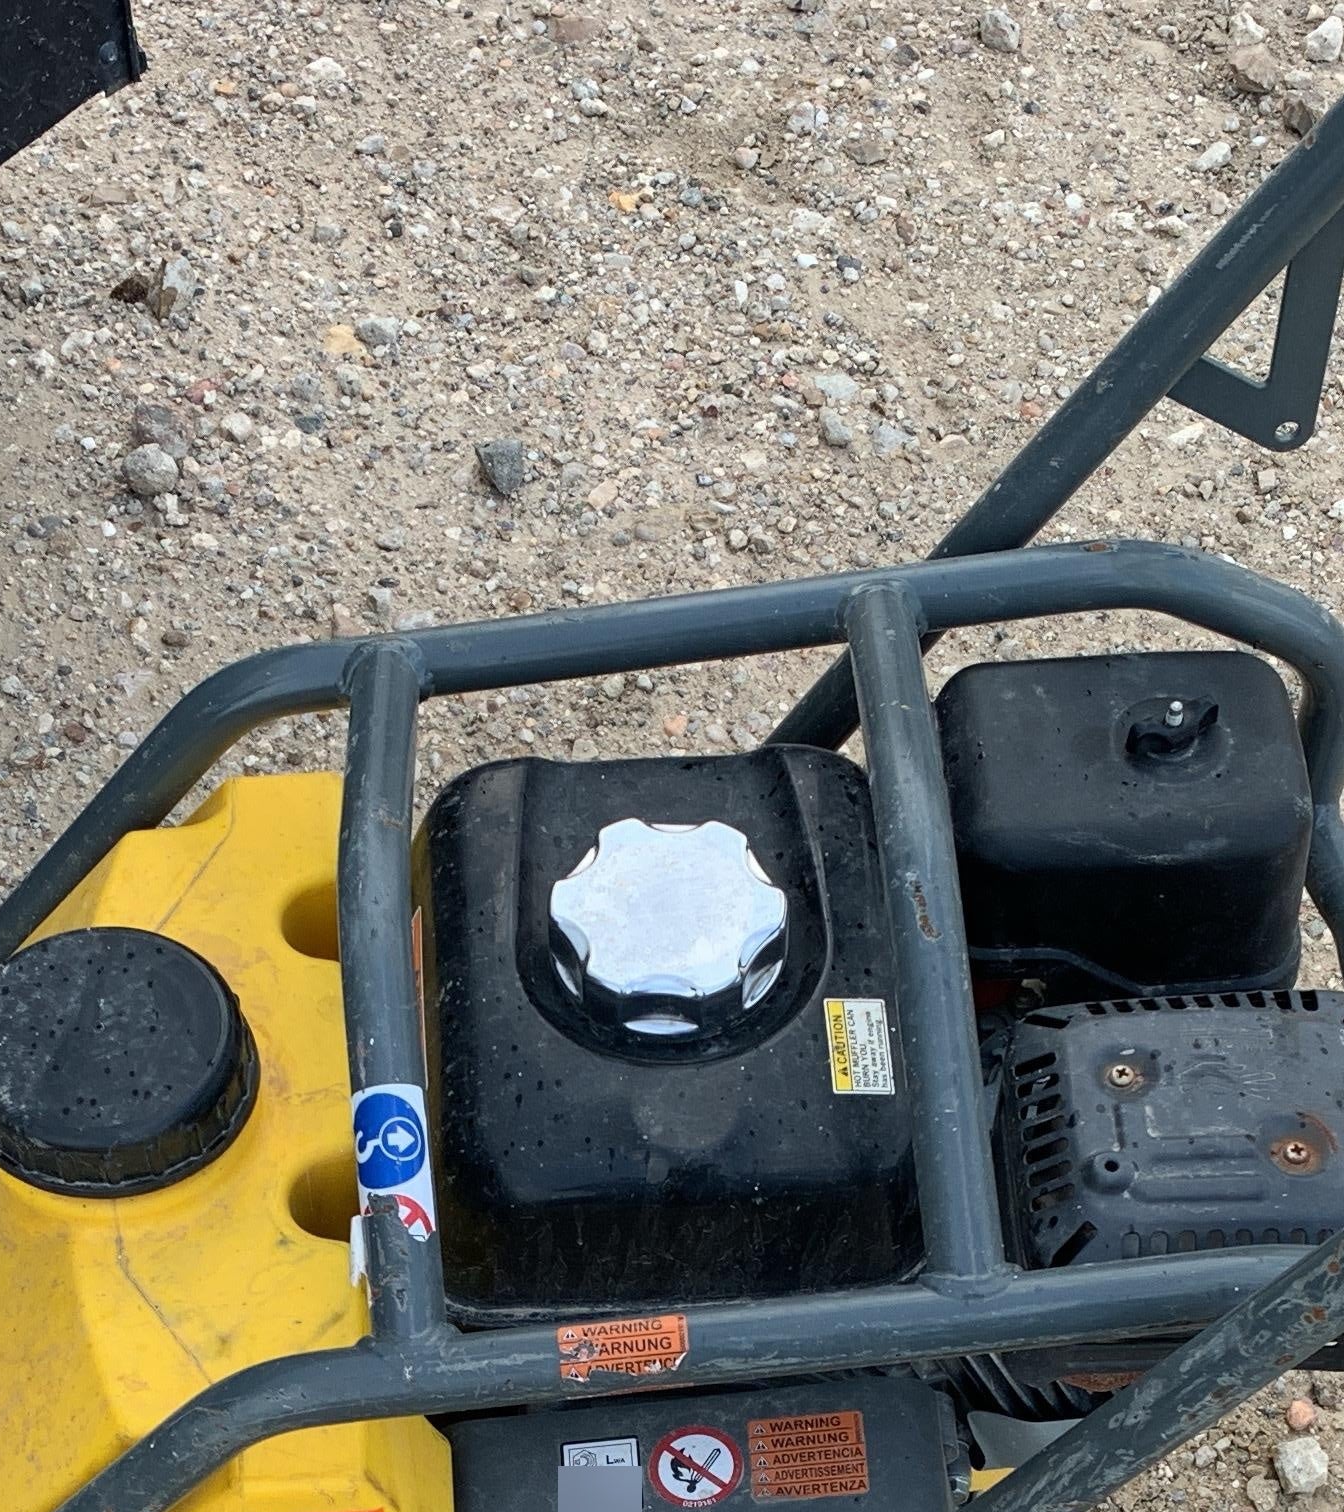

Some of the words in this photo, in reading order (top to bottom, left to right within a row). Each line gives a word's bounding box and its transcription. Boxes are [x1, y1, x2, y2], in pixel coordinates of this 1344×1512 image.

[847, 1009, 856, 1027] CAN
[832, 1014, 848, 1064] CAUTION
[848, 1029, 860, 1068] MUFFLER
[853, 1071, 862, 1087] HOT
[862, 1064, 872, 1088] BURN
[582, 1319, 663, 1338] WARNING
[594, 1337, 672, 1357] ARNUNG
[769, 1416, 841, 1433] WARNING
[771, 1431, 849, 1449] WARNUNG
[773, 1447, 864, 1466] ADVERTENCIA
[774, 1462, 865, 1481] ADVERTISSEMENT
[776, 1479, 867, 1496] AVVERTENZA
